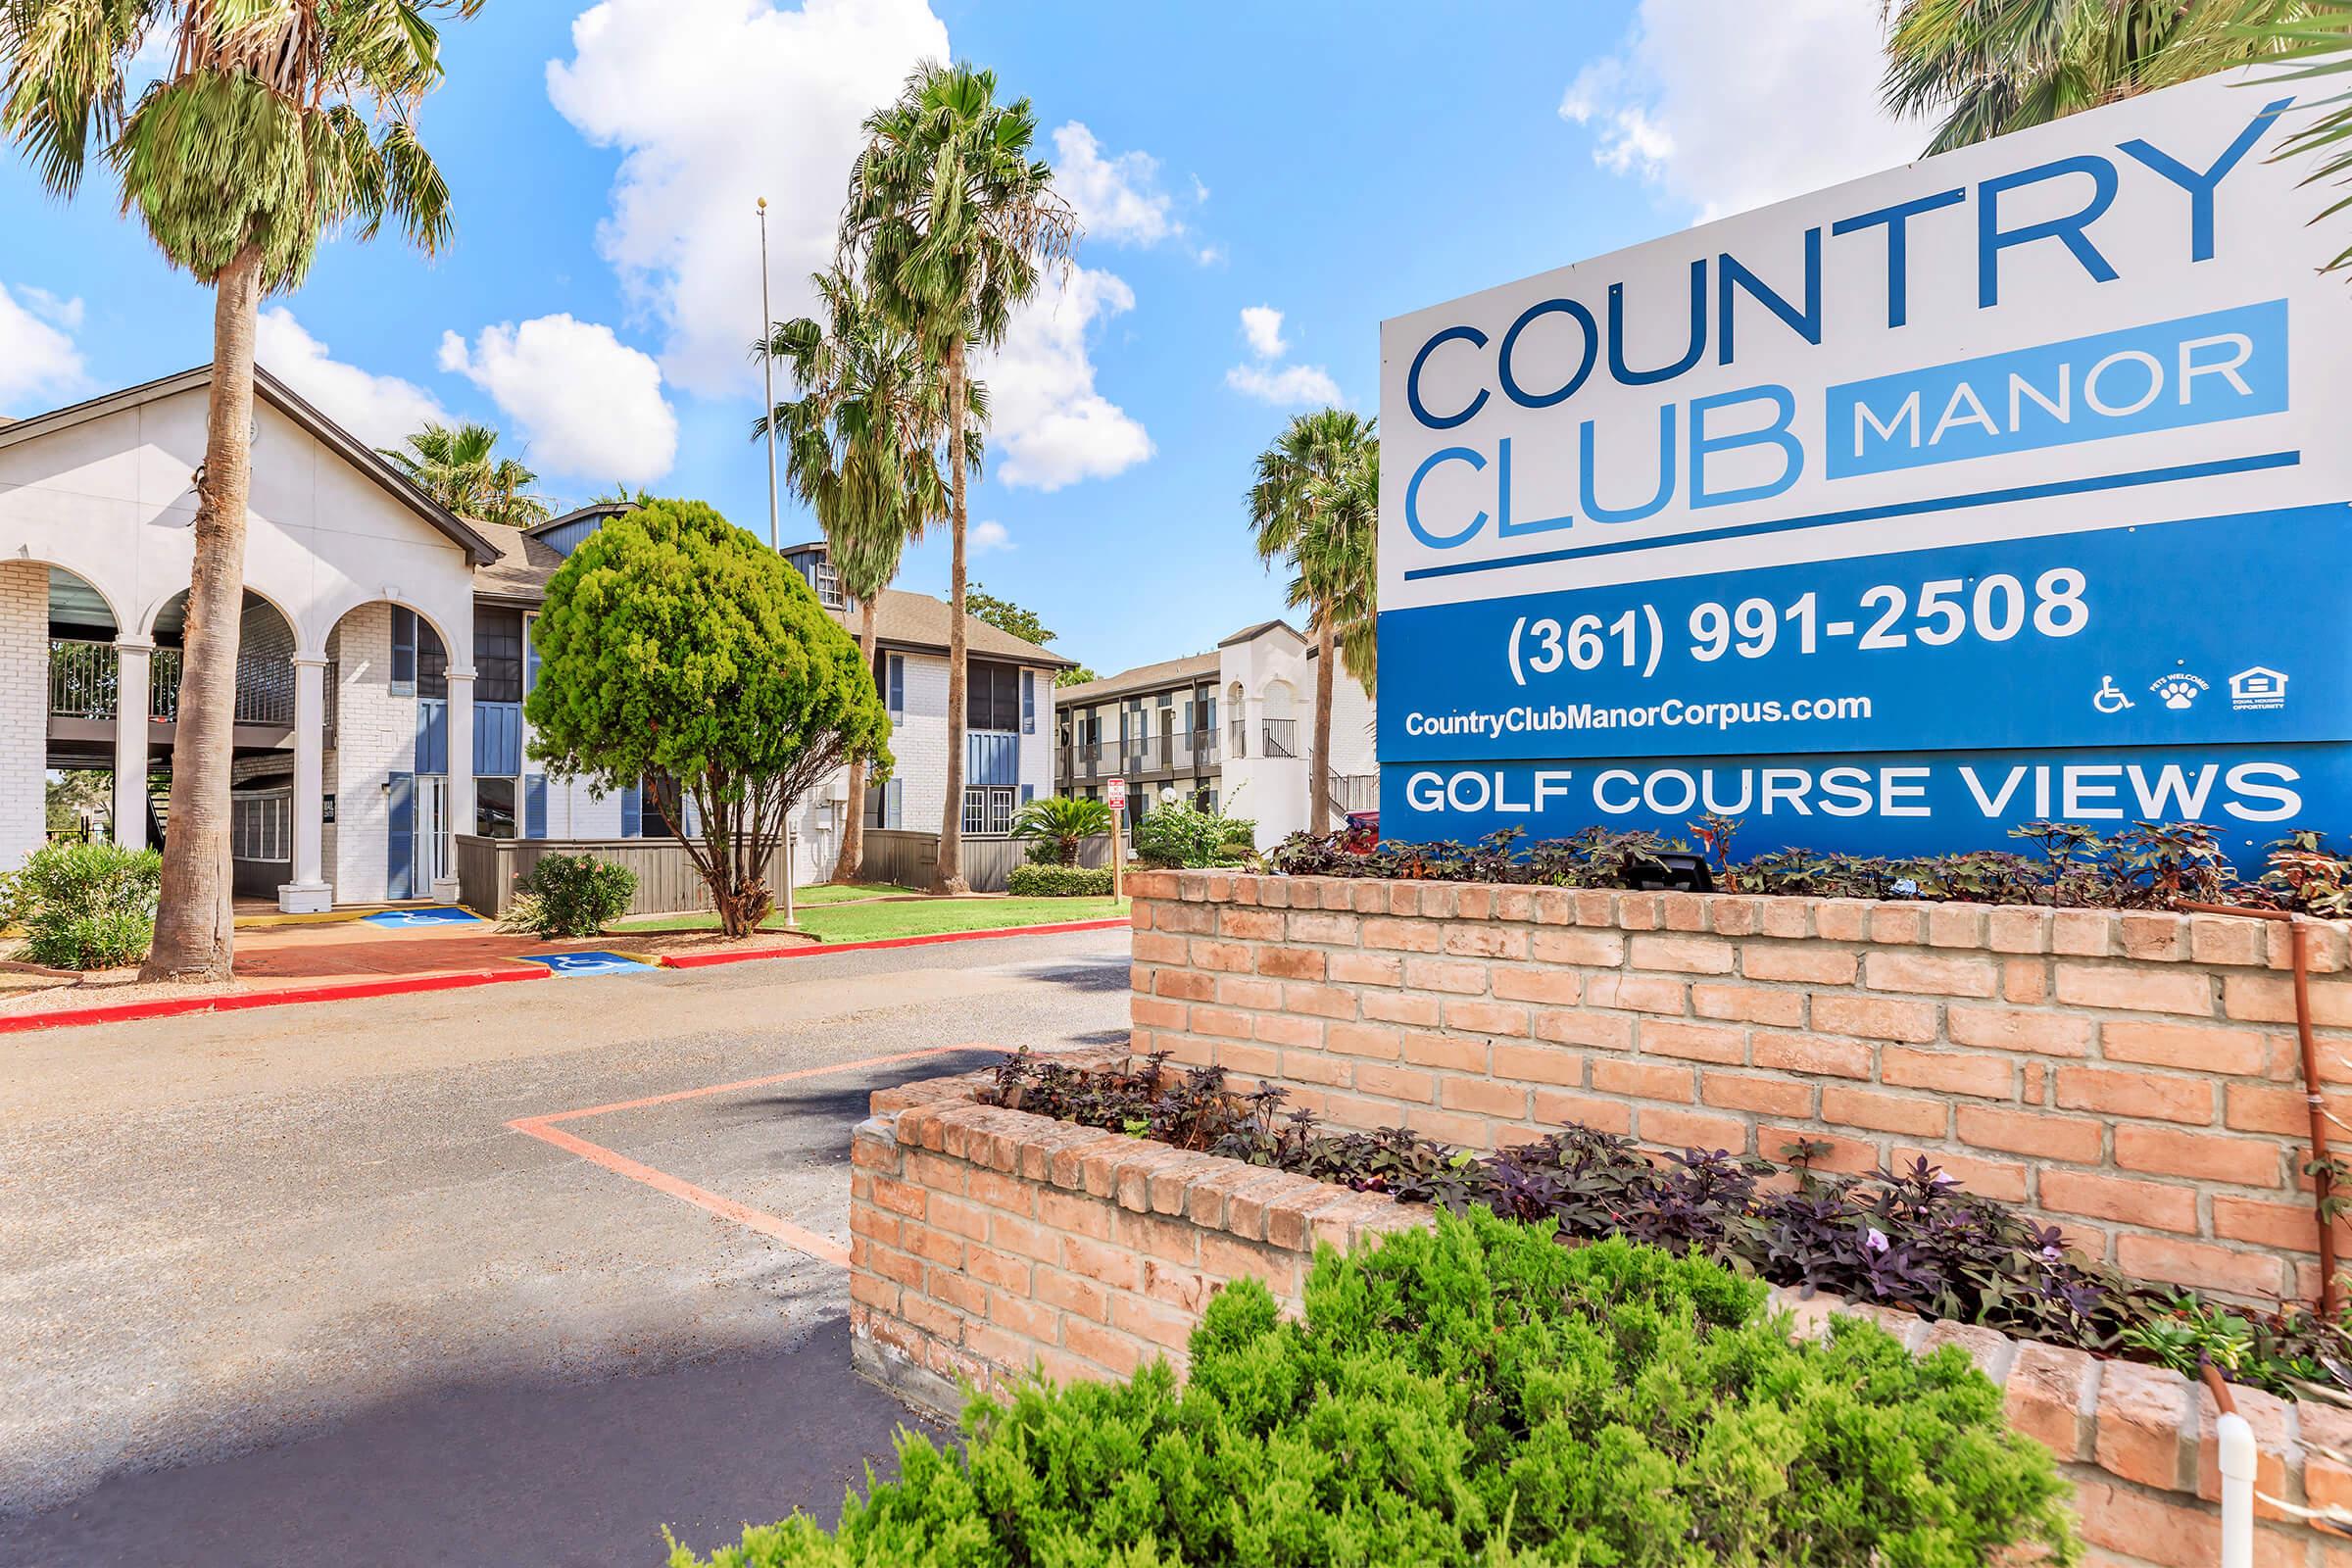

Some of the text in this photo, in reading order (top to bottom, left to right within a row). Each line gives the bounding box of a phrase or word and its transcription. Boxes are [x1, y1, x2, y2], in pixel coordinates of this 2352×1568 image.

[1406, 96, 2297, 430] COUNTRY
[1404, 332, 2255, 550] CLUB MANOR
[1507, 566, 2090, 686] (361) 991-2508
[1404, 695, 1873, 739] CountryClubManorCorpus.com
[1405, 761, 2303, 822] GOLF COURSE VIEWS
